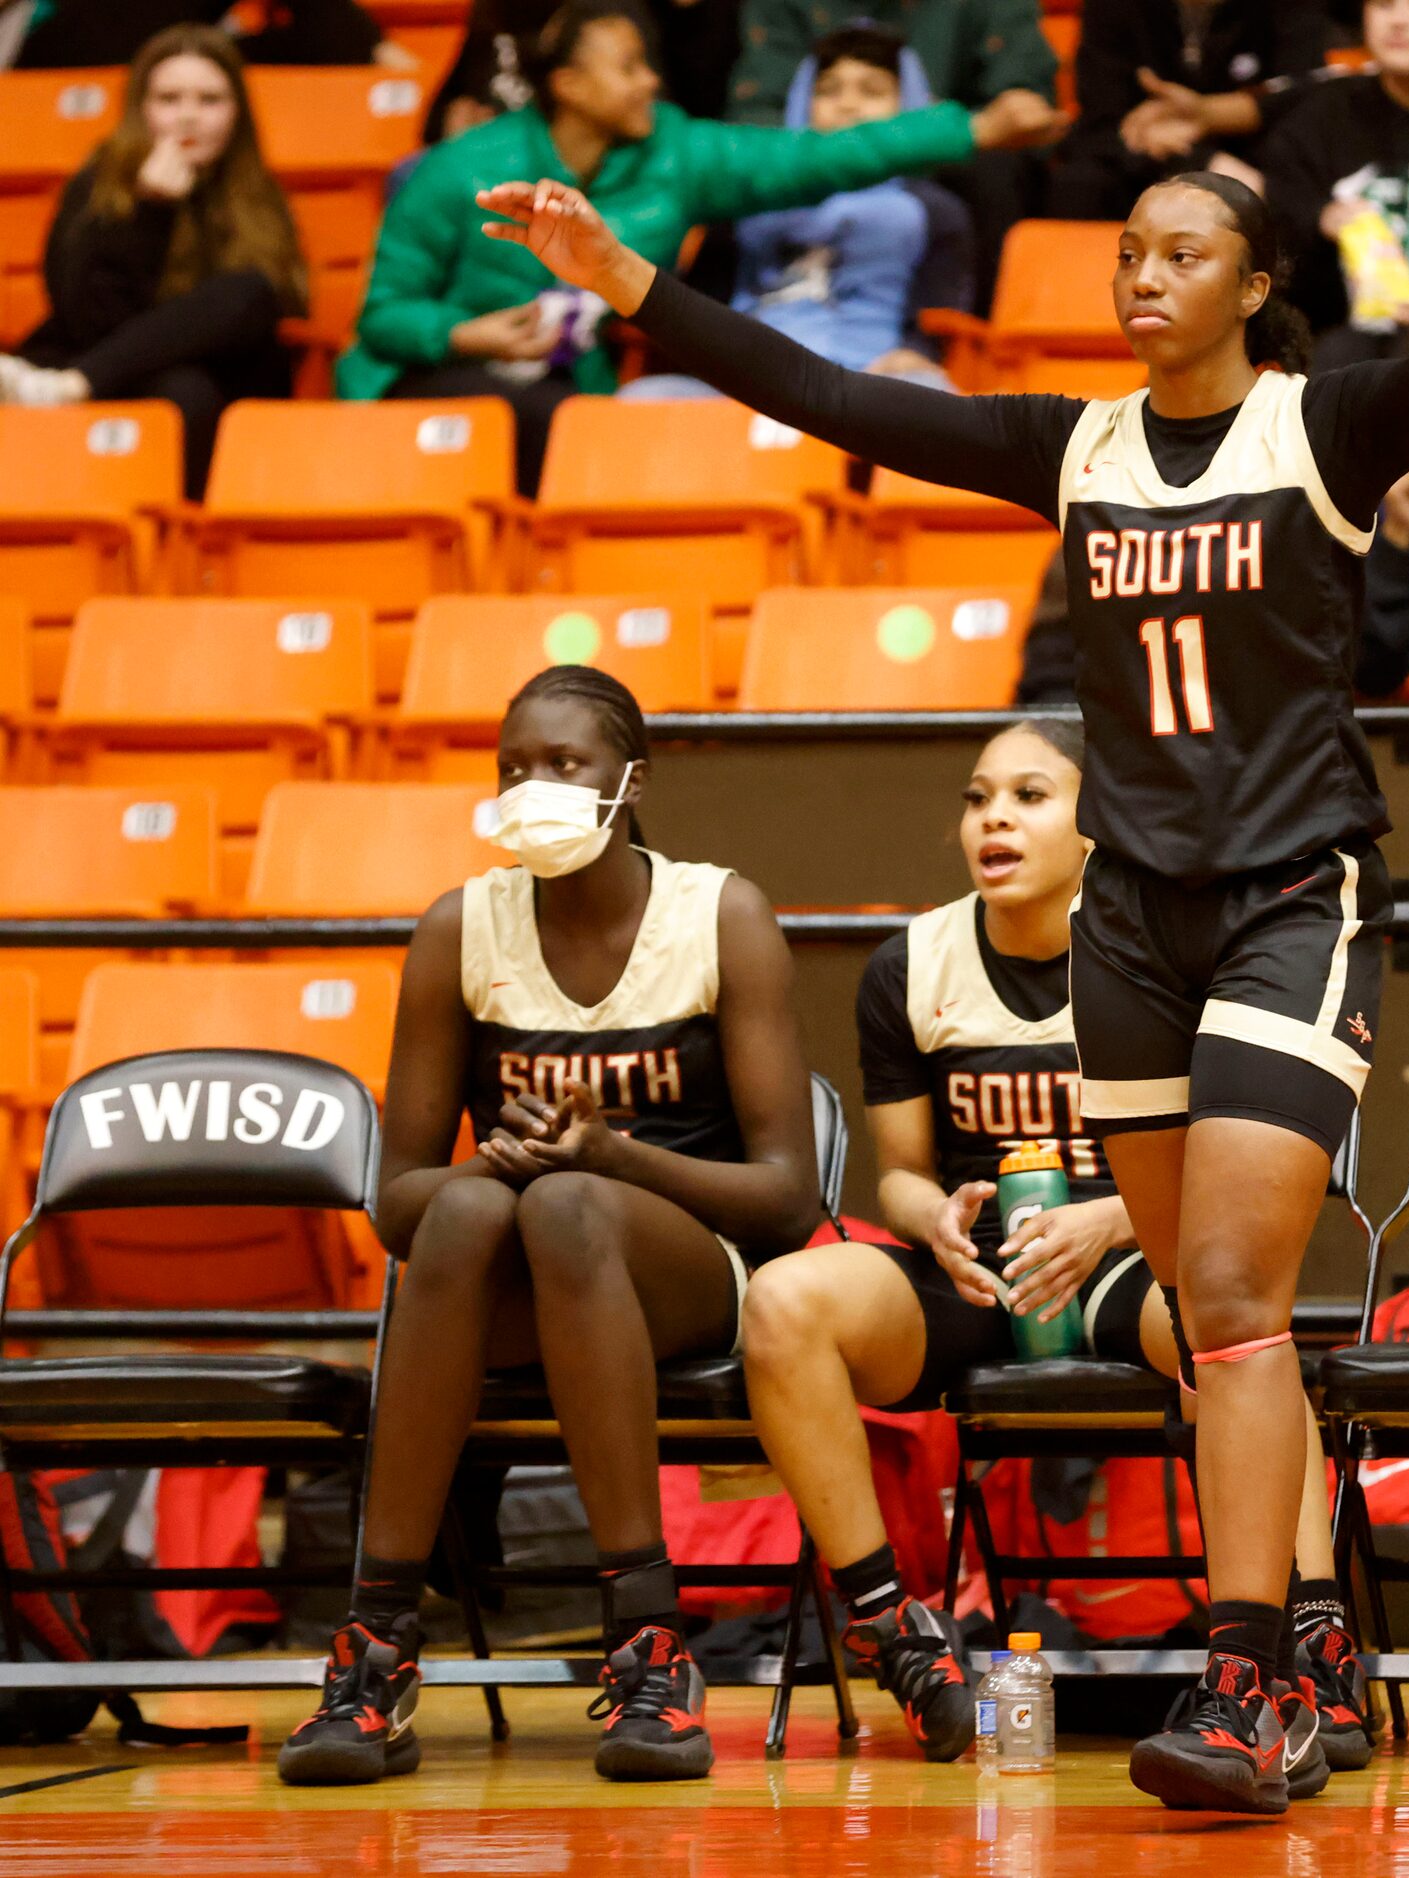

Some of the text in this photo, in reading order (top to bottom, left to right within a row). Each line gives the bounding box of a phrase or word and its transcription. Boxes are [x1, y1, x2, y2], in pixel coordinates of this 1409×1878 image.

[1086, 519, 1264, 600] SOUTH
[1138, 614, 1214, 737] 11
[79, 1080, 345, 1150] FWISD
[1010, 1703, 1032, 1730] G
